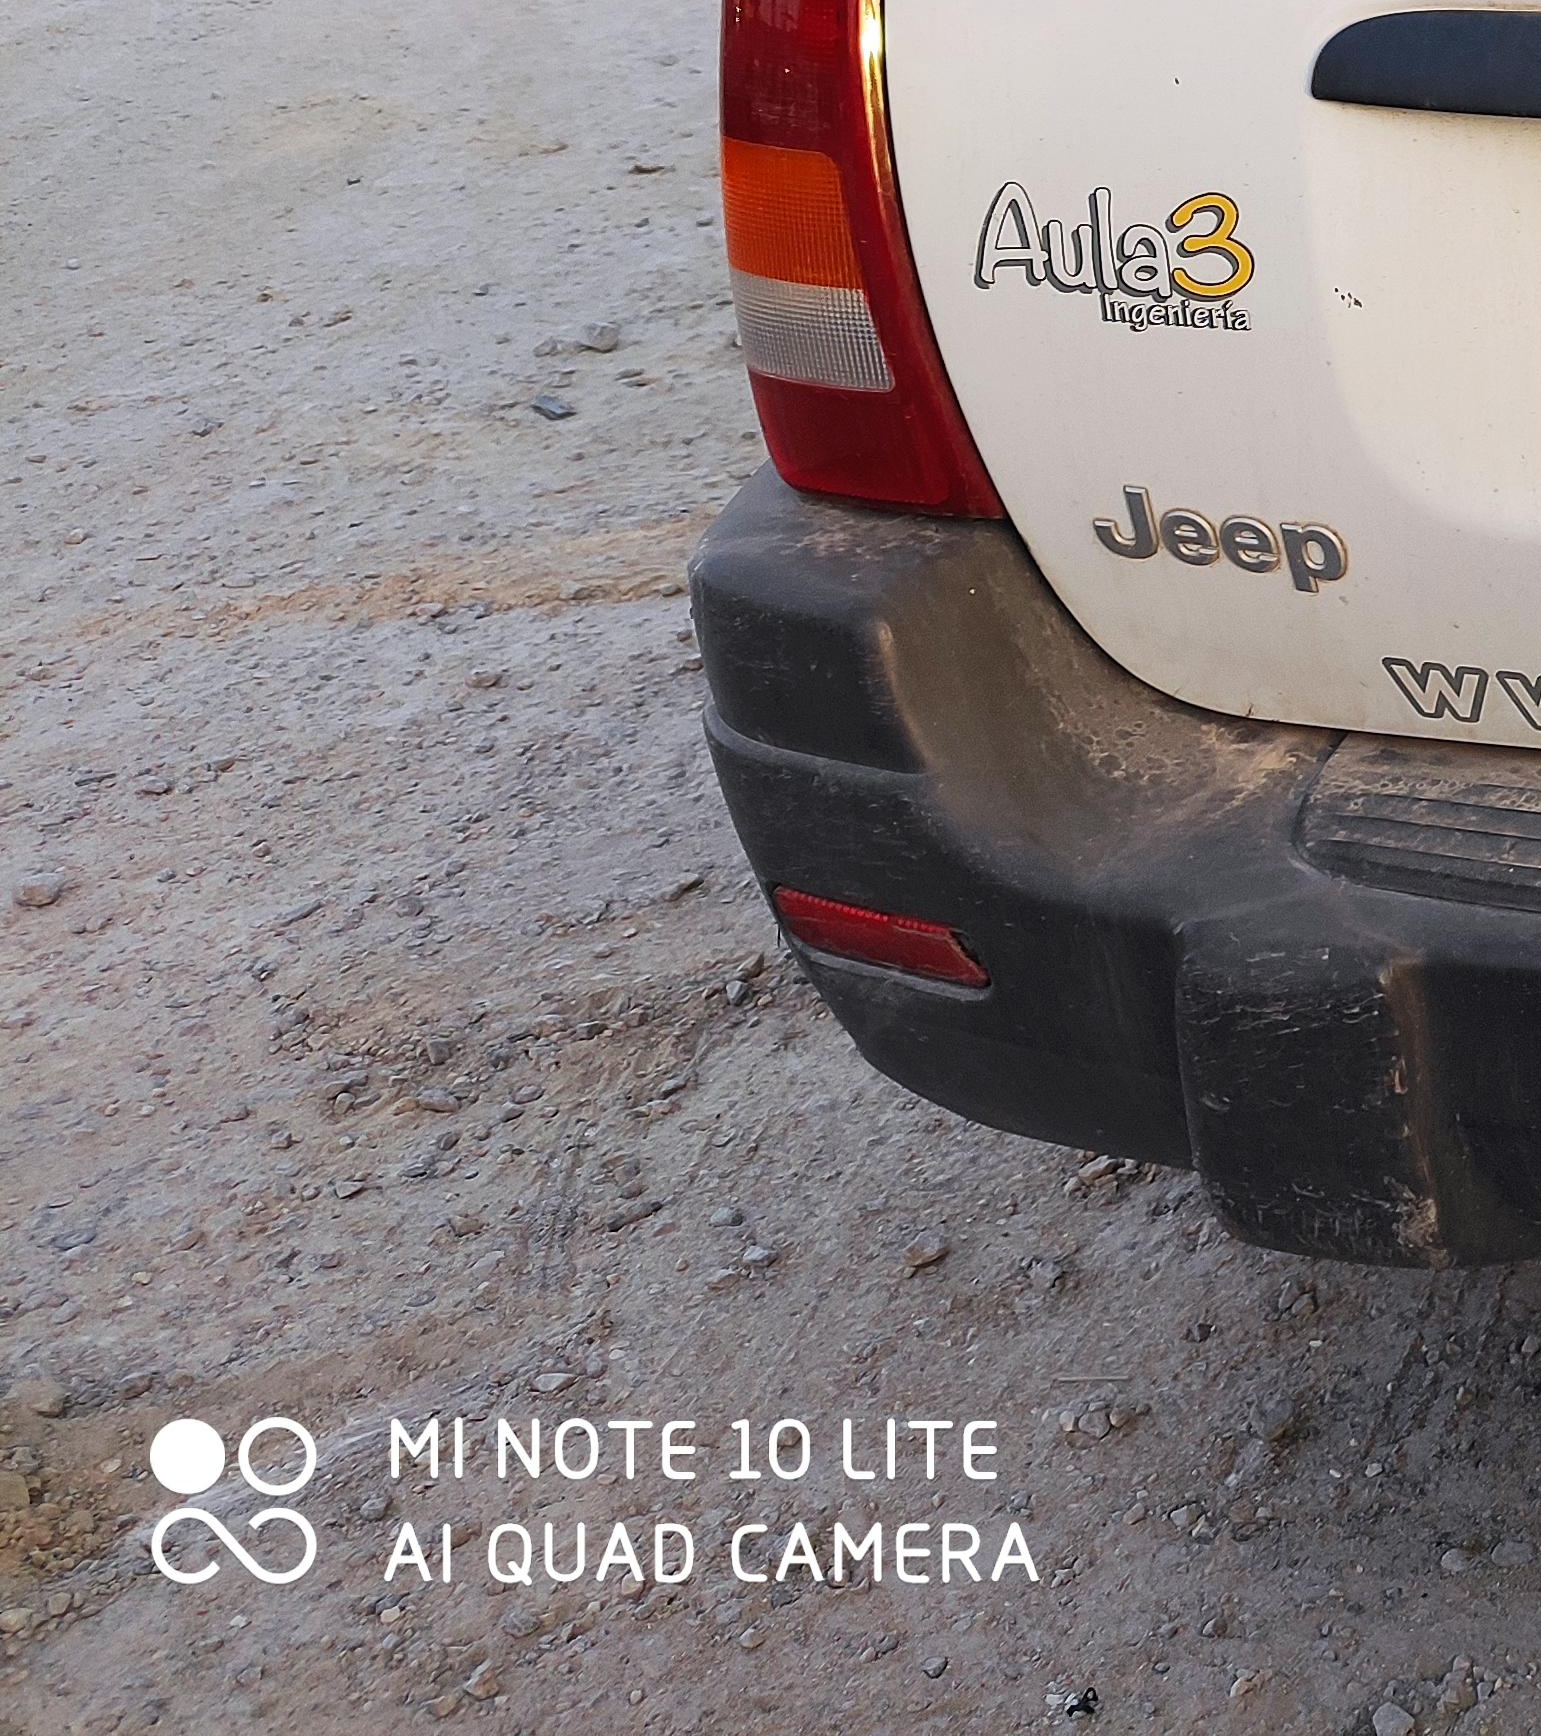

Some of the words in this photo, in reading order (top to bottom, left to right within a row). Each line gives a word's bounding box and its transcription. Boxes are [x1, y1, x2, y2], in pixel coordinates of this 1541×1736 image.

[974, 181, 1255, 302] Aula3
[1101, 293, 1252, 331] Ingeniería
[1092, 484, 1349, 594] Jeep
